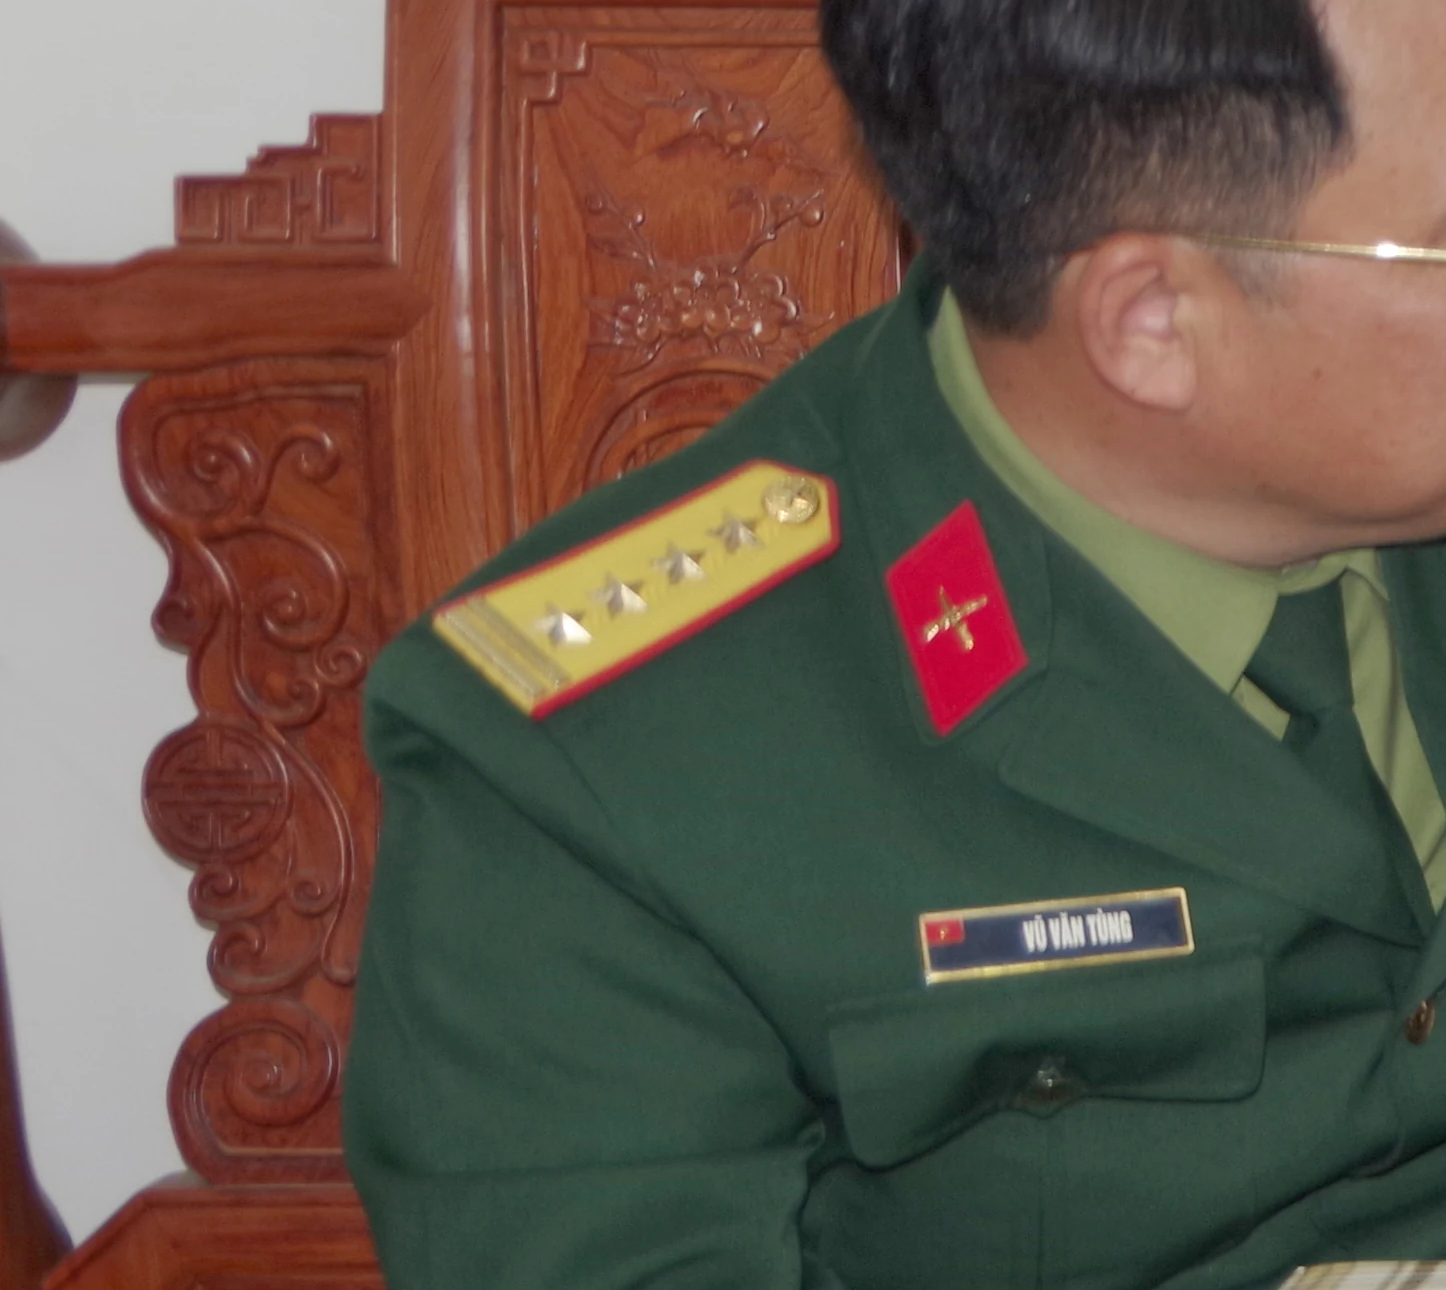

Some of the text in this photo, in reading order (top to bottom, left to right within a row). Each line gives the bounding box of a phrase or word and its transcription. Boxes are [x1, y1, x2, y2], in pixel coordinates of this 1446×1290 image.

[1023, 907, 1134, 953] VŨ VĂN TÙNG
